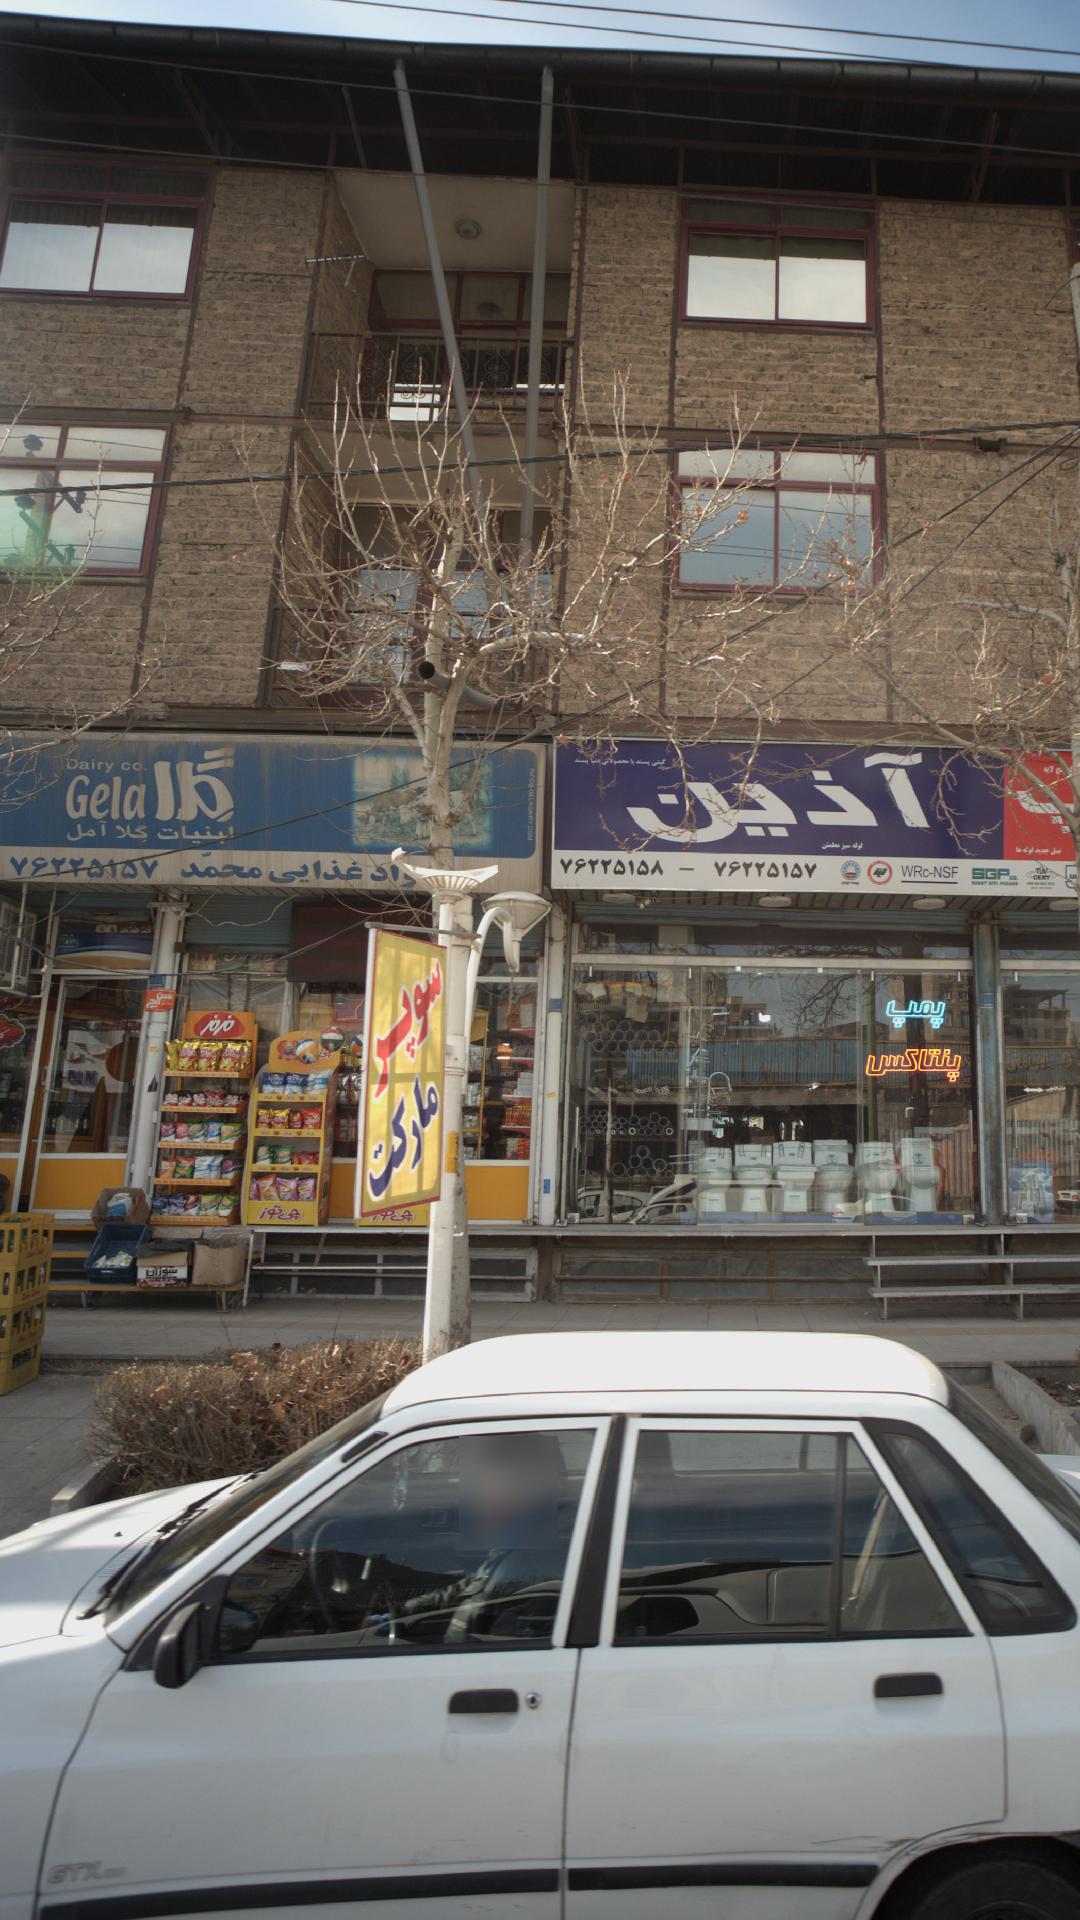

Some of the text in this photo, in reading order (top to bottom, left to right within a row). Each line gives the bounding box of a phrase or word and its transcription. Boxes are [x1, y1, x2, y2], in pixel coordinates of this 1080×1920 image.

[66, 759, 114, 773] Dairy
[65, 775, 146, 820] Gela
[153, 748, 235, 822] گلا
[626, 751, 931, 843] آذین
[67, 821, 235, 843] لبنیات گلا آمل
[9, 856, 159, 880] ۷۶۲۲۵۱۵۷
[269, 858, 363, 885] غذایی
[371, 862, 418, 888] واد
[560, 857, 664, 876] ۷۶۲۲۵۱۵۸
[714, 860, 817, 879] ۷۶۲۲۵۱۵۷
[901, 865, 959, 879] WRc-NSF
[972, 867, 1010, 880] SGP
[885, 998, 946, 1029] پمپ
[374, 958, 443, 1103] سوپر
[865, 1047, 962, 1083] پنتاکس
[367, 1075, 440, 1202] مارکت
